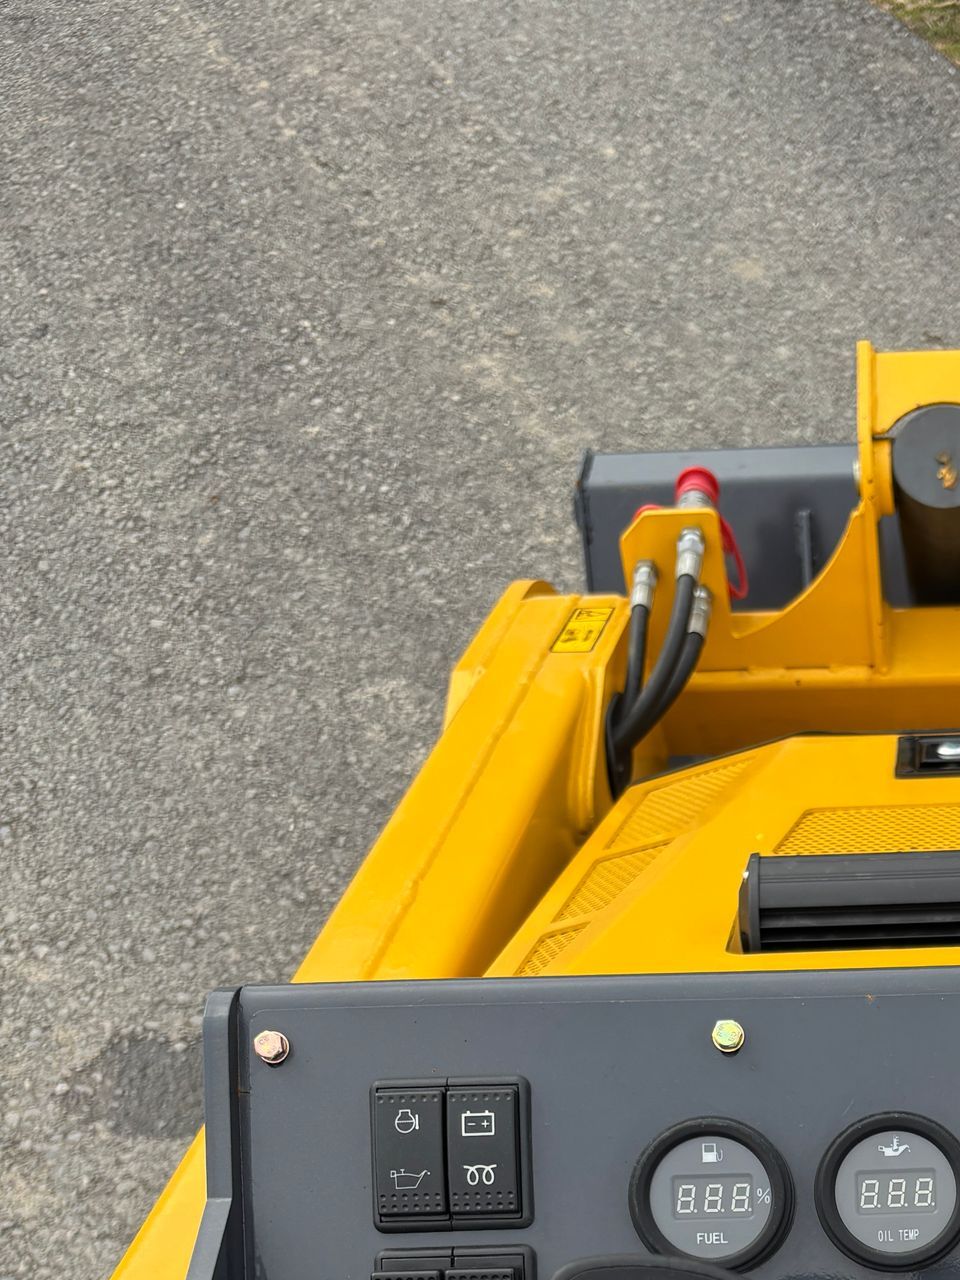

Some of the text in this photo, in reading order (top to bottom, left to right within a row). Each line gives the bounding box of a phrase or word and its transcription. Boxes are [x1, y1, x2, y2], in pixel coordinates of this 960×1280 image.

[696, 1232, 729, 1245] FUEL
[877, 1229, 920, 1242] OIL TEMP
